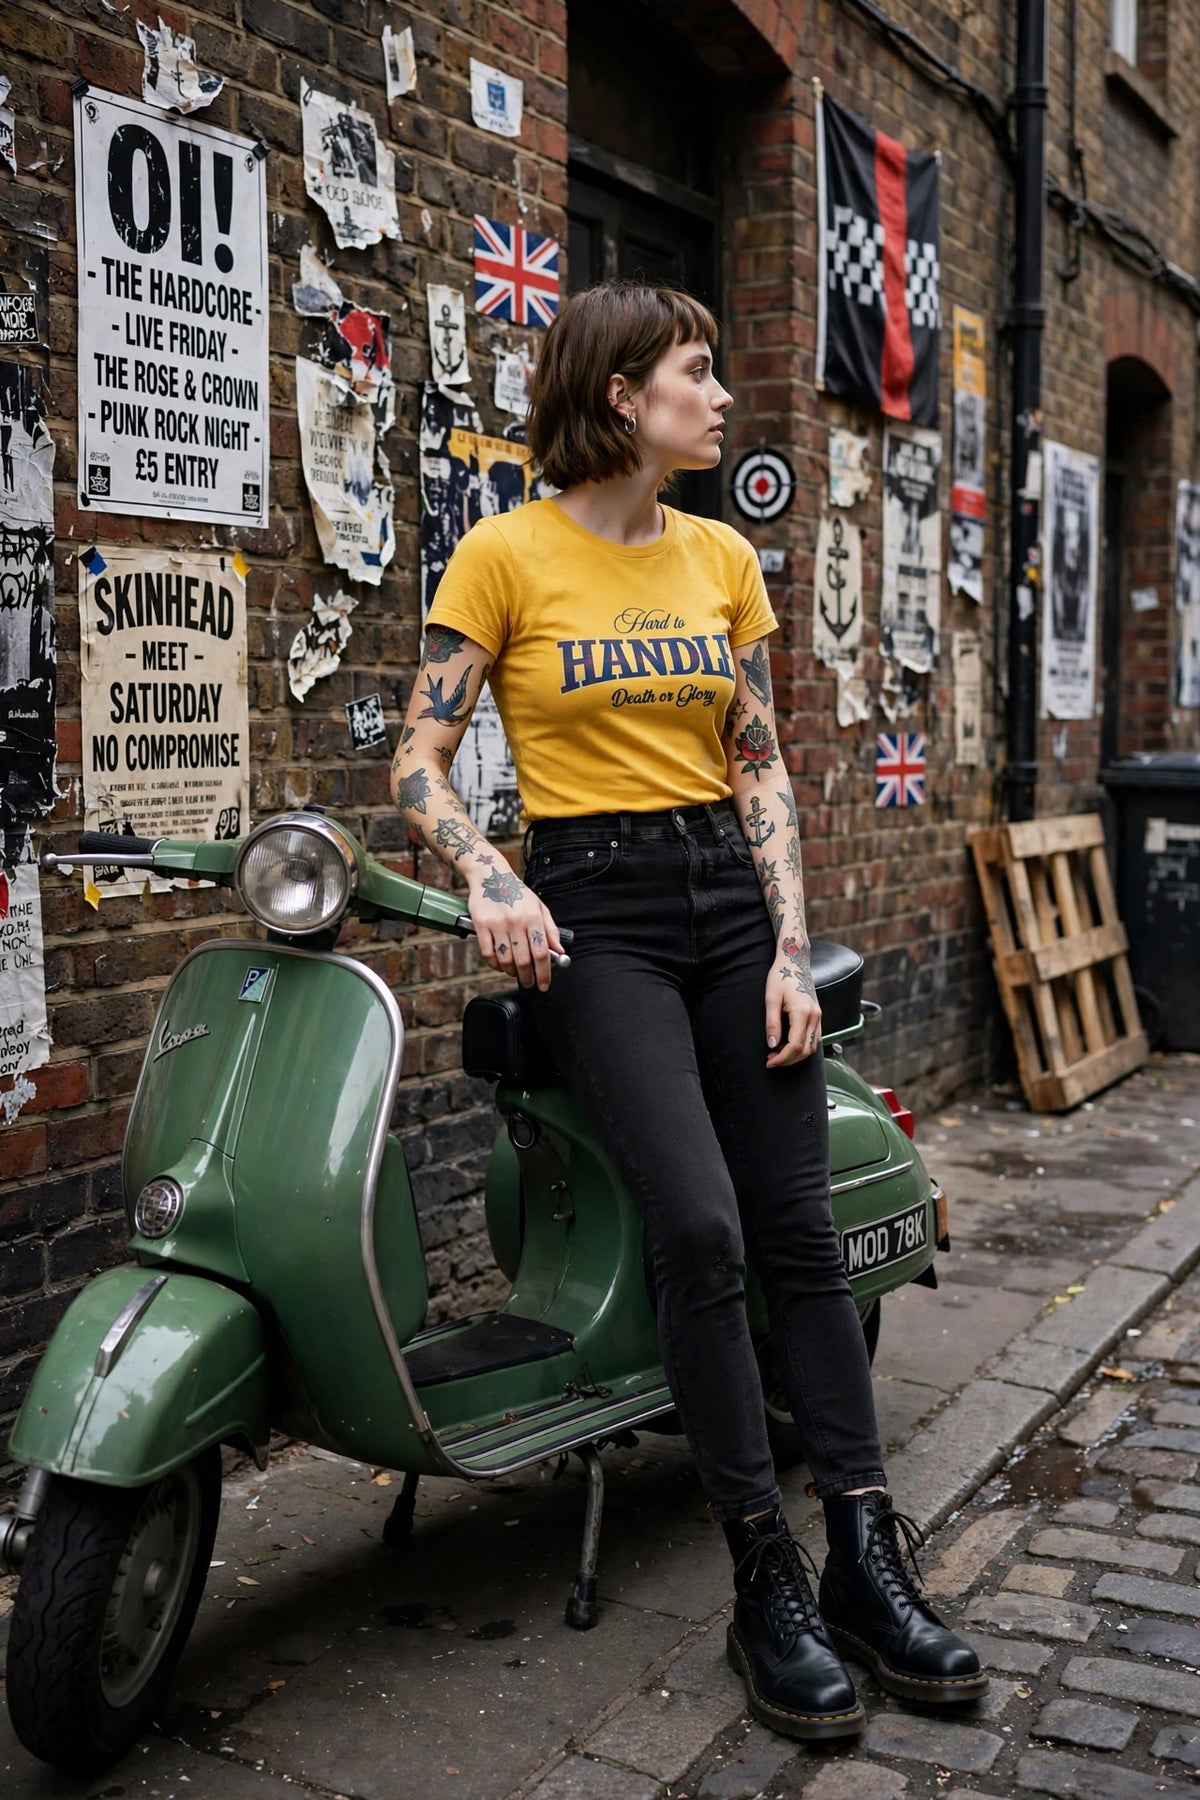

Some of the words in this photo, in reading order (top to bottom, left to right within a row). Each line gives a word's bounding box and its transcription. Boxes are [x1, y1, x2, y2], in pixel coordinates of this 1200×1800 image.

[107, 122, 235, 274] OI!
[101, 256, 143, 302] THE
[150, 268, 253, 326] HARDCORE
[125, 312, 164, 351] LIVE
[169, 321, 227, 363] FRIDAY
[93, 352, 129, 390] THE
[134, 359, 179, 398] ROSE
[184, 369, 197, 401] &
[202, 371, 259, 412] CROWN
[101, 399, 150, 439] PUNK
[155, 408, 200, 445] ROCK
[204, 415, 250, 452] NIGHT
[135, 448, 158, 483] £5
[164, 452, 219, 490] ENTRY
[94, 572, 234, 641] SKINHEAD
[613, 607, 672, 634] Hard
[673, 616, 686, 630] to
[142, 640, 188, 671] MEET
[110, 681, 223, 724] SATURDAY
[611, 688, 657, 708] Death
[659, 691, 674, 702] or
[675, 684, 717, 708] Glory
[92, 734, 119, 772] NO
[125, 733, 240, 772] COMPROMISE
[848, 1226, 889, 1272] MOD
[893, 1209, 925, 1254] 78K
